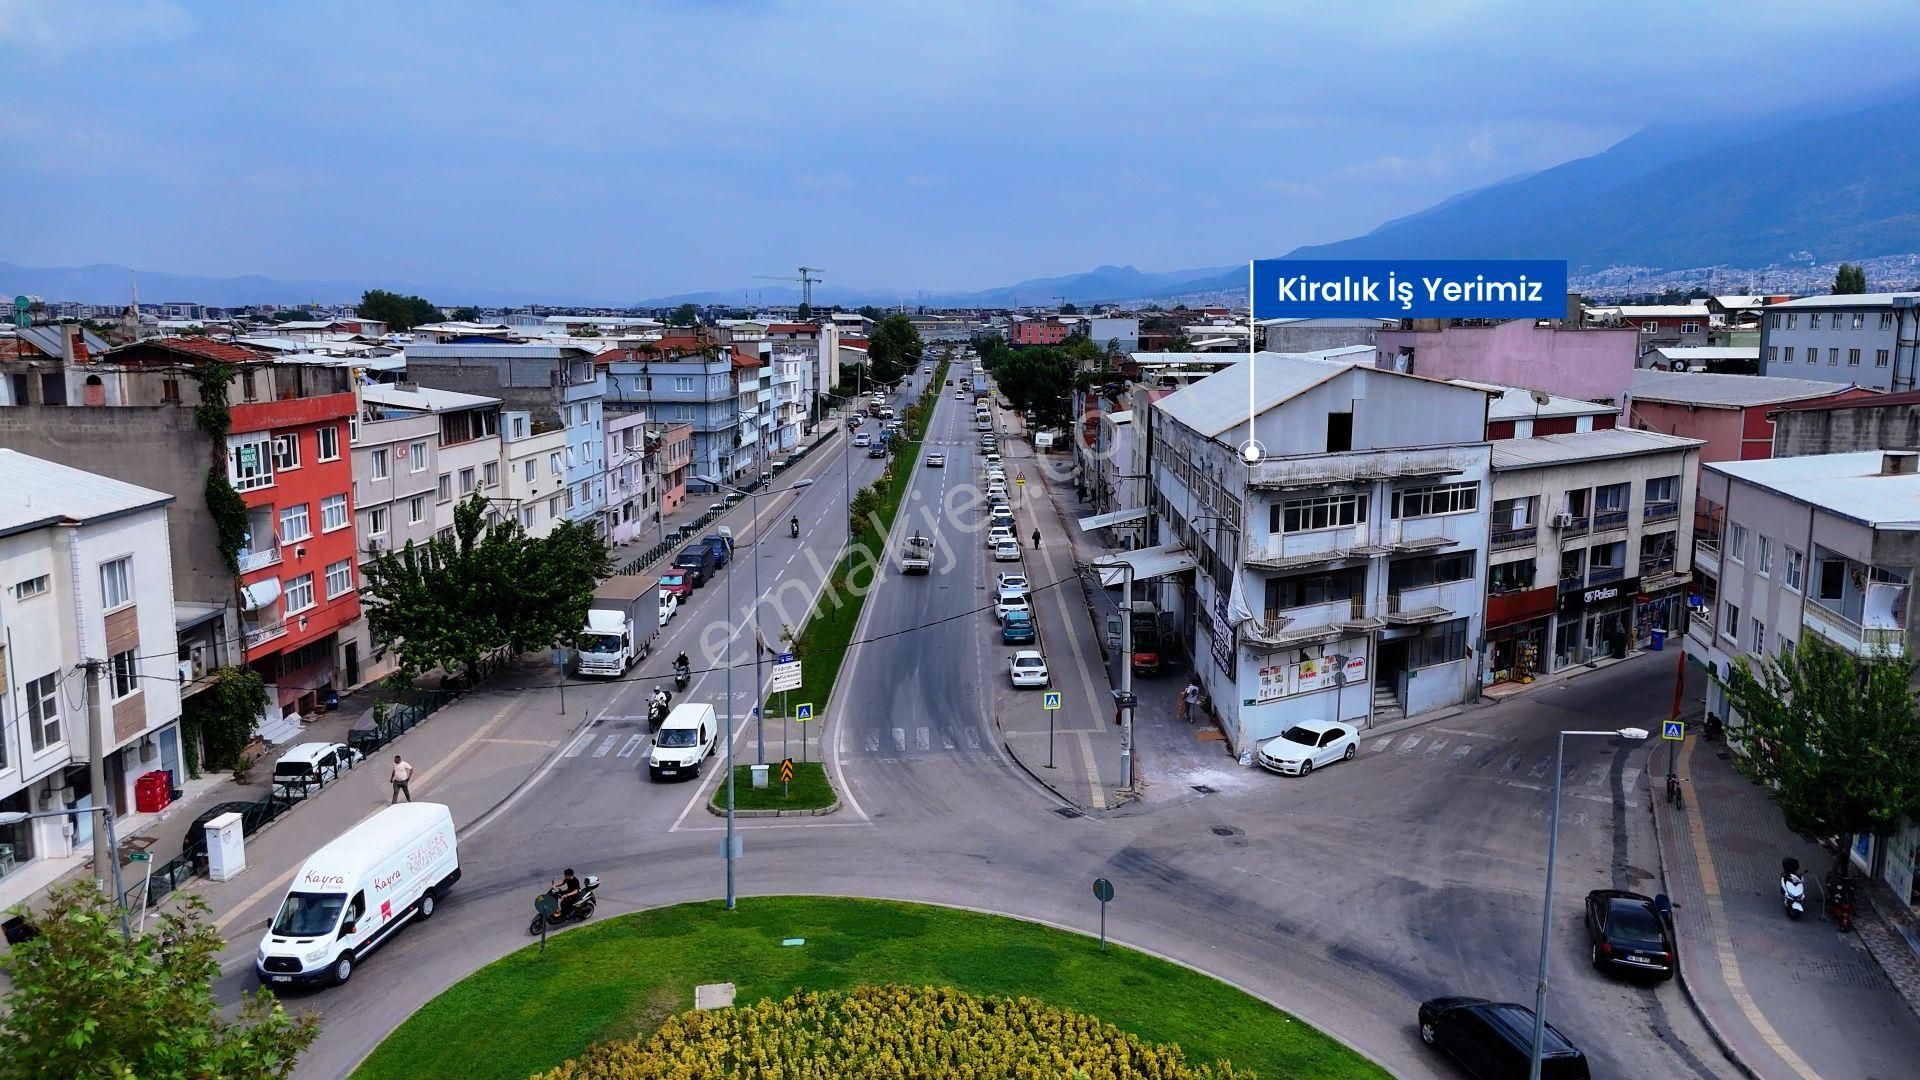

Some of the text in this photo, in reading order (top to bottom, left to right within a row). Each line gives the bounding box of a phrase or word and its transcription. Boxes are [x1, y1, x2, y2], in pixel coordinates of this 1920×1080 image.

[1594, 588, 1618, 601] Polisan
[305, 868, 344, 889] Kayra
[374, 870, 401, 892] Kayra
